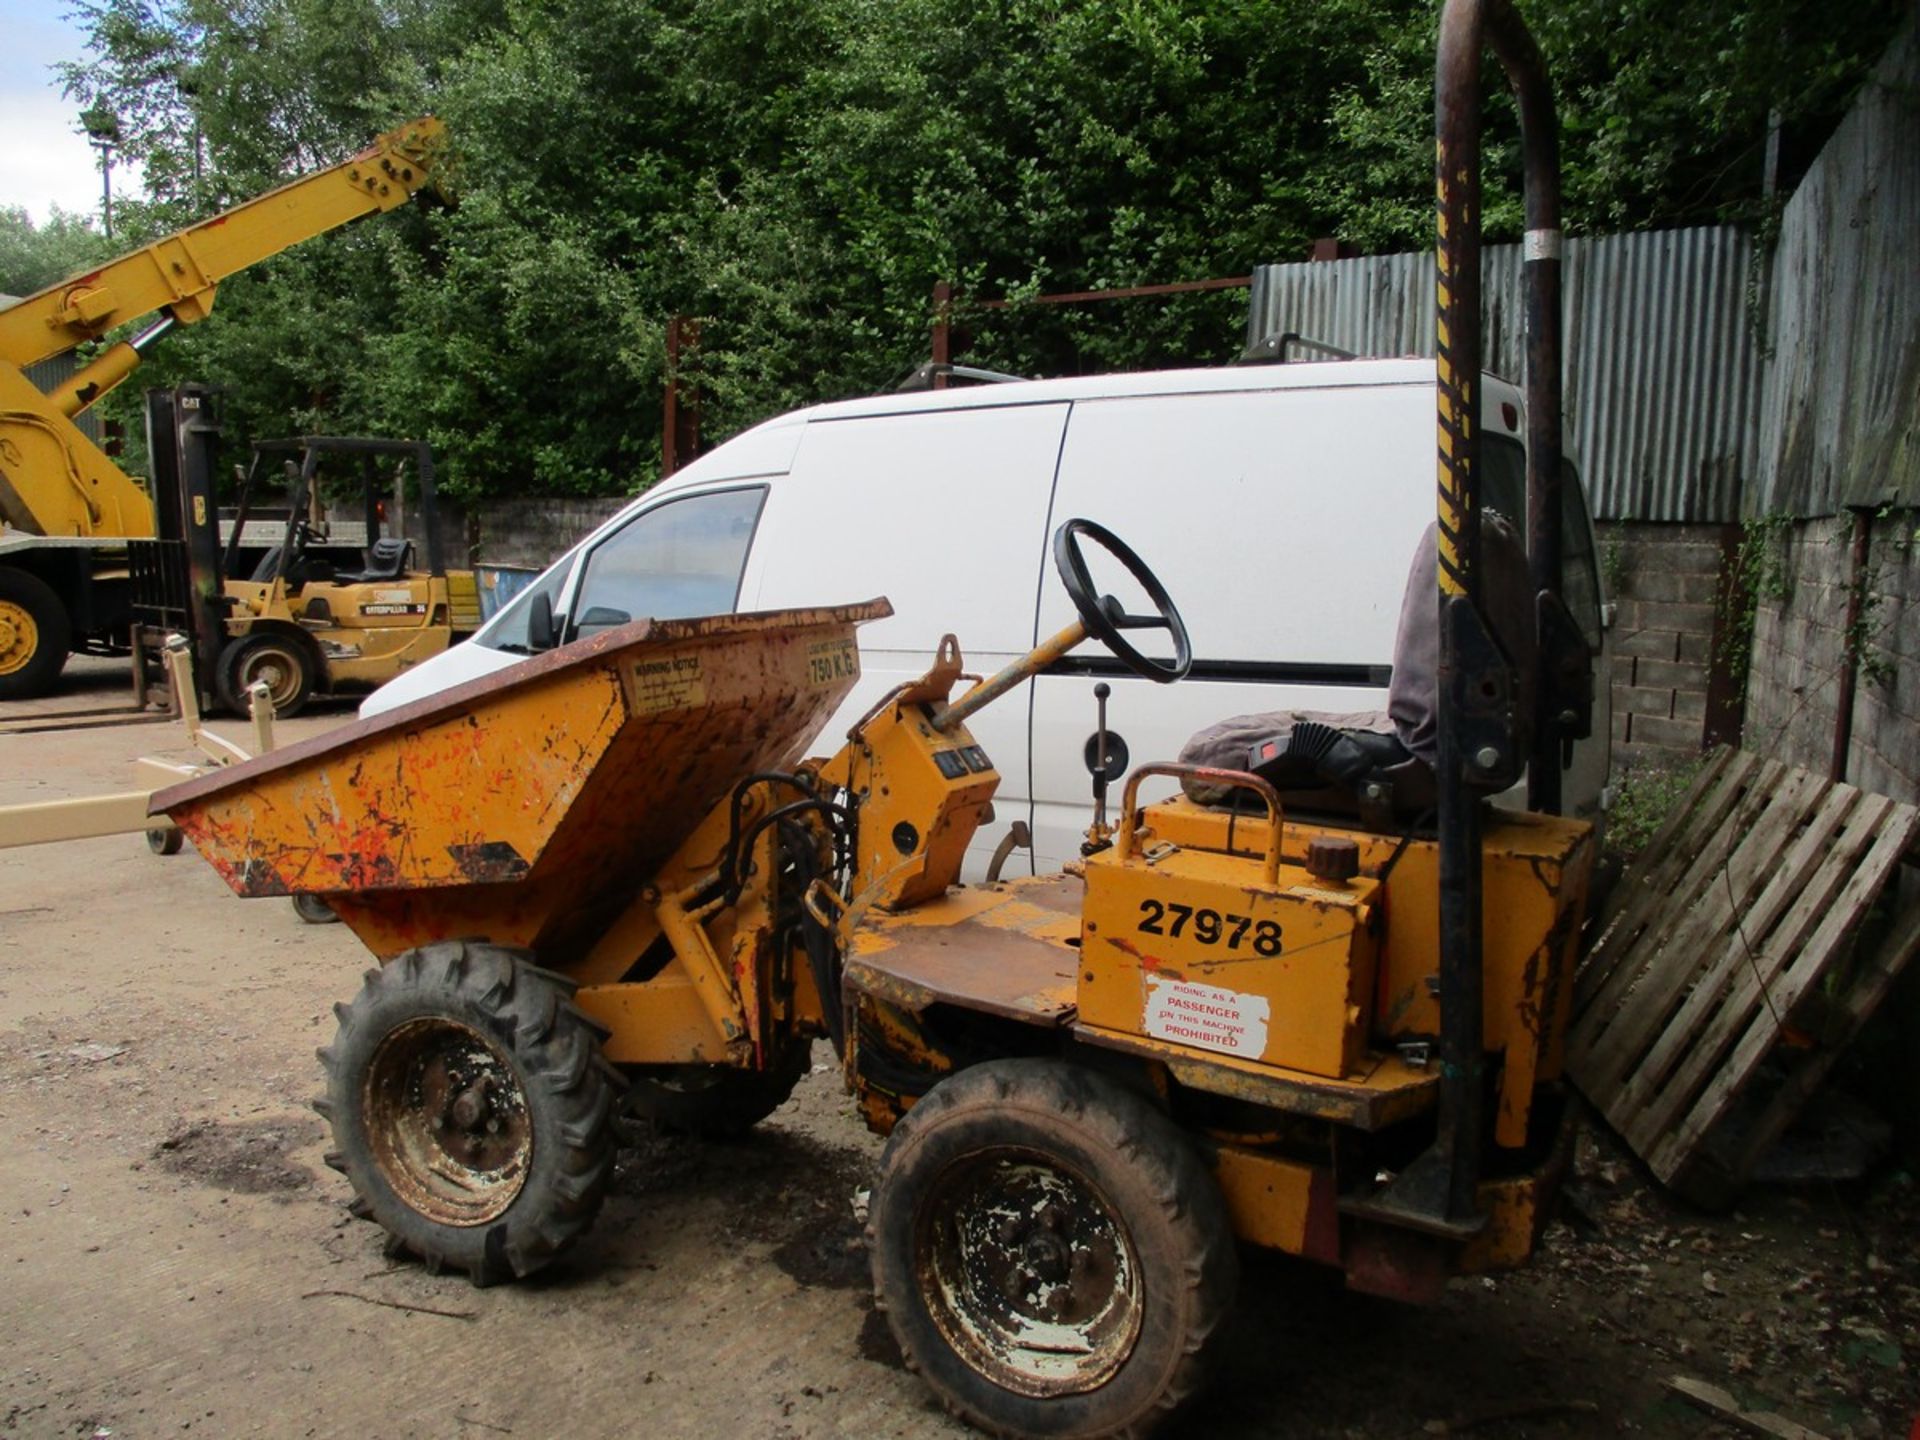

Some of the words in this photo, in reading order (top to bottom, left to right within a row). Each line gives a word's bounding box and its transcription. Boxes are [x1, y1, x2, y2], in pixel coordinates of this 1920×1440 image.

[182, 397, 200, 408] CAT
[672, 656, 699, 671] NOTICE
[811, 657, 832, 683] 750
[1138, 899, 1282, 957] 27978
[1173, 984, 1206, 998] RIDING
[1212, 991, 1225, 1002] AS
[1229, 996, 1237, 1005] A
[1167, 997, 1240, 1020] PASSENGER
[1159, 1010, 1174, 1019] ON
[1178, 1014, 1199, 1025] THIS
[1203, 1019, 1245, 1035] MACHINE
[1165, 1023, 1239, 1048] PROHIBITED
